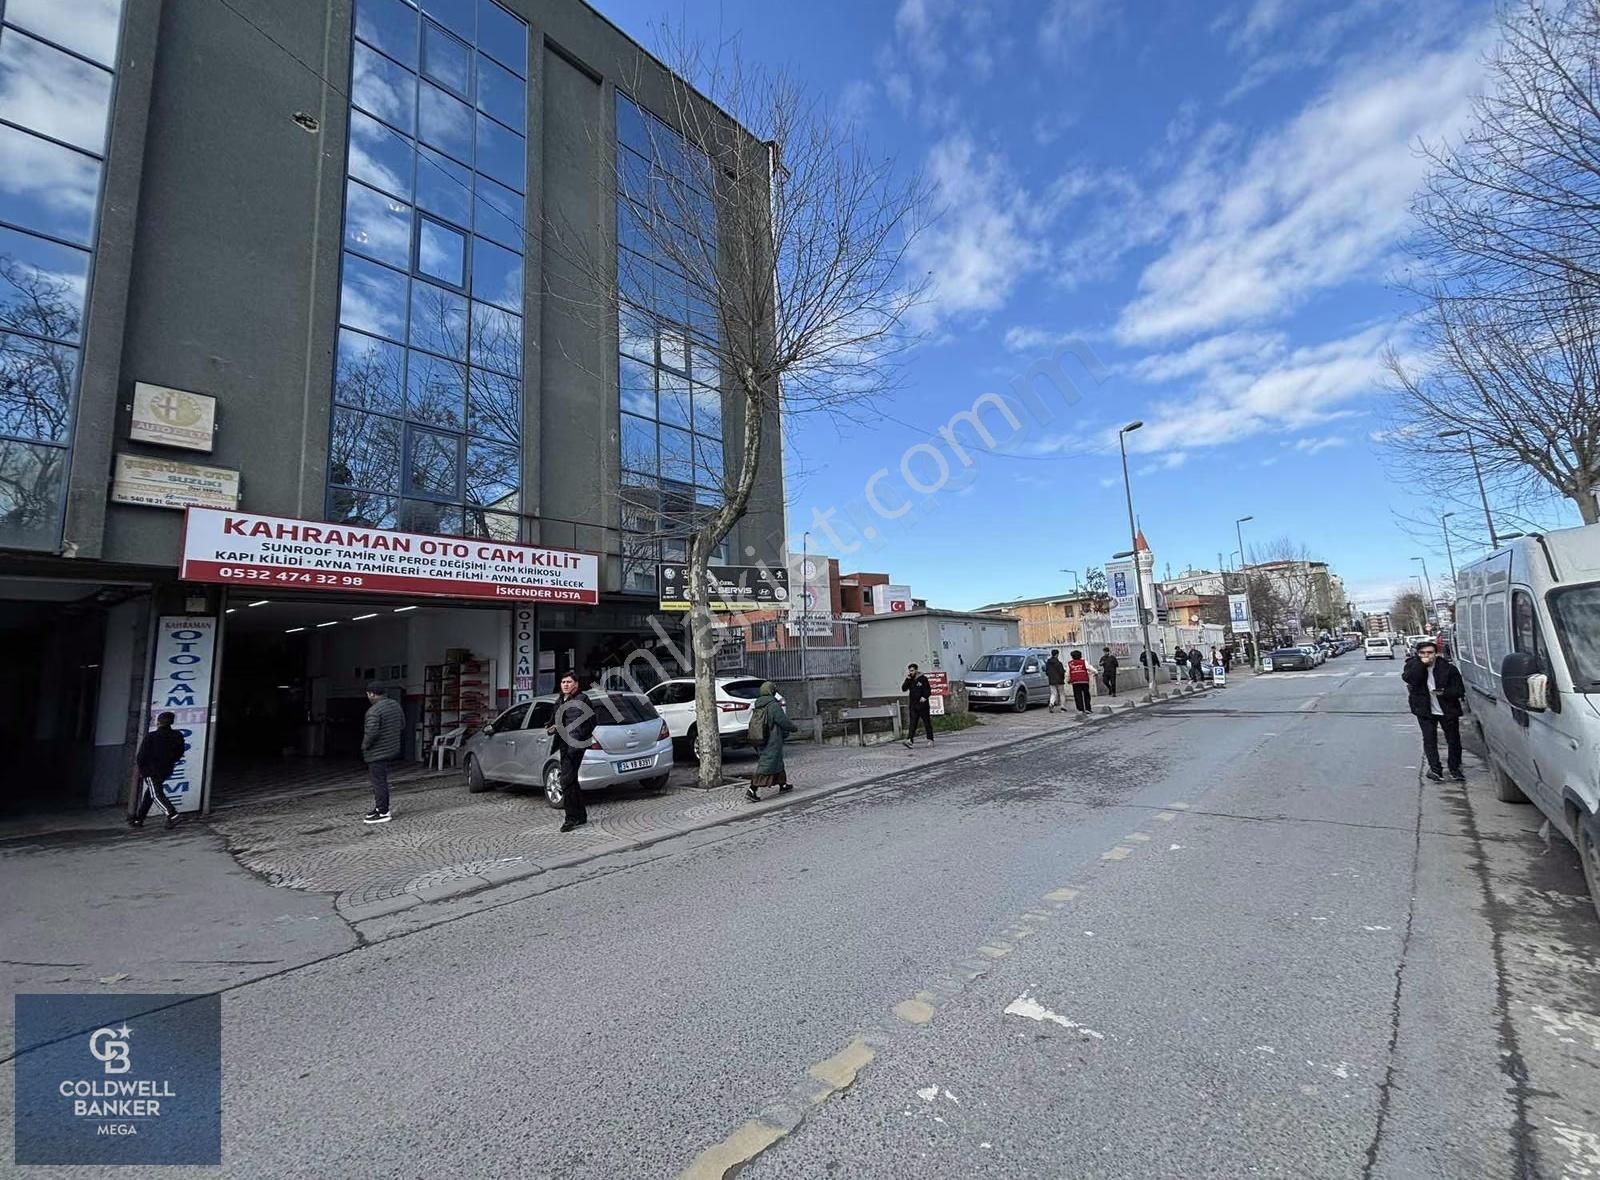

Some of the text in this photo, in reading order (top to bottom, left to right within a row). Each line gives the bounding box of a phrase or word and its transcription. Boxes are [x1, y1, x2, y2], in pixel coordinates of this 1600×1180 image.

[168, 475, 222, 487] SUZUKI
[223, 517, 581, 569] KAHRAMAN OTO CAM KİLİT
[215, 550, 585, 588] KAPI KİLİDİ AYNA TAMİRLERİ CAM FİLMİ AYNA CAMI SİLECEK
[261, 542, 561, 578] SUNROOF TAMİR VE PERDE DEĞİŞİMİ CAM KİRİKOSU
[219, 567, 363, 586] 0532 474 32 98
[496, 585, 581, 600] İSKENDER USTA
